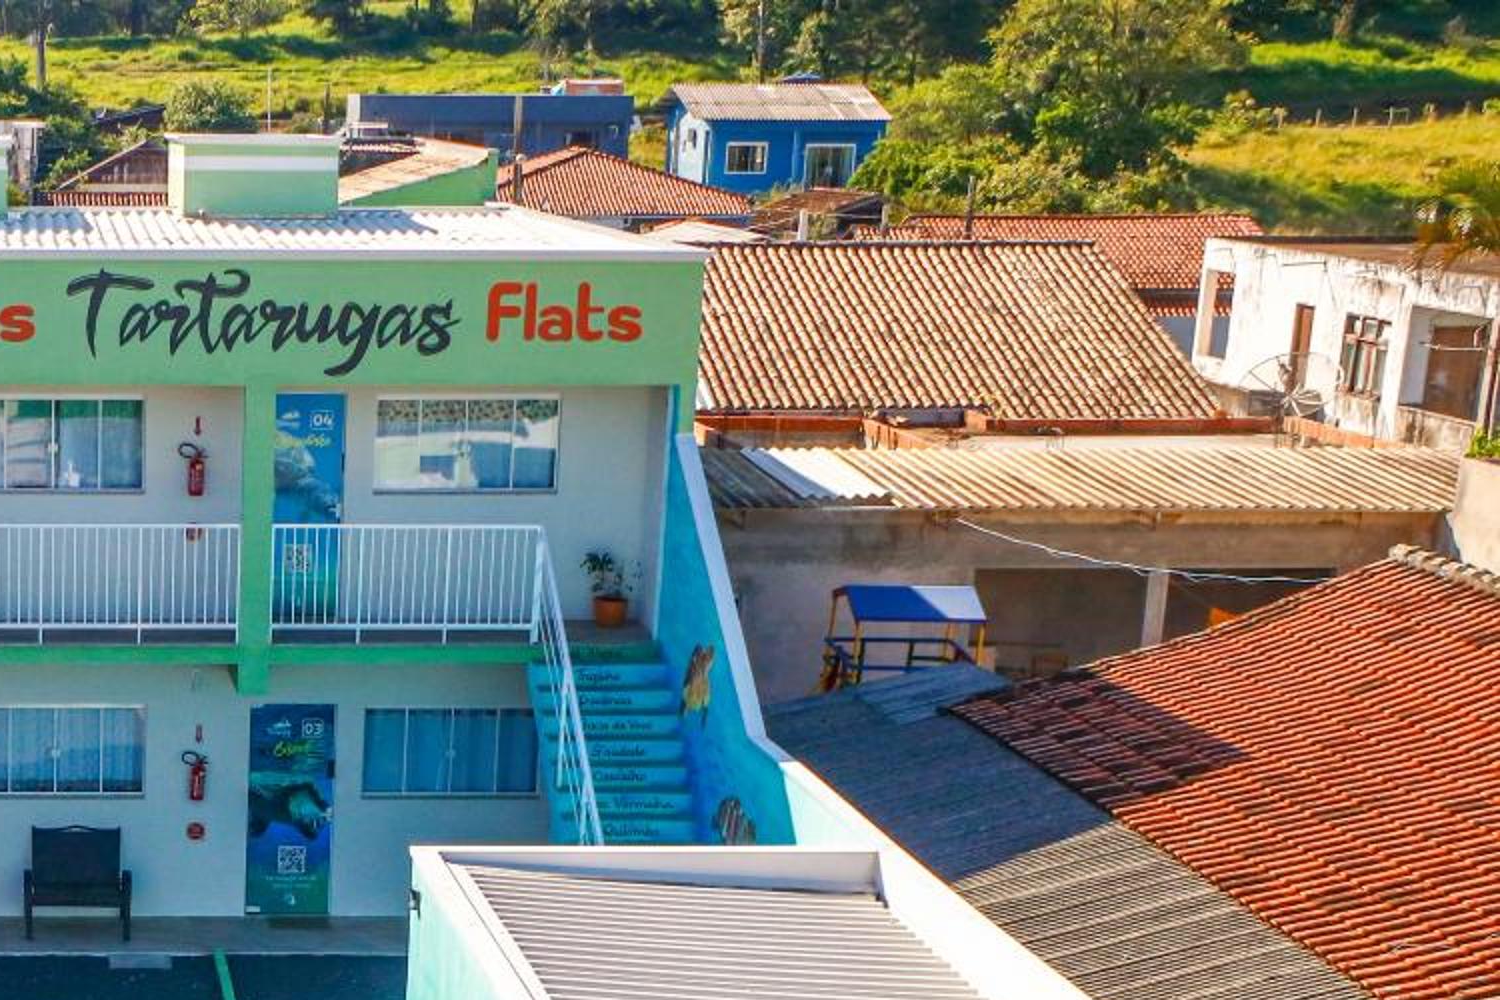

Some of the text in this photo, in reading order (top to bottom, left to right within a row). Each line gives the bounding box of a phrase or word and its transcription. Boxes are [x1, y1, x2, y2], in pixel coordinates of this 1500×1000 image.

[66, 267, 461, 376] Tartarugas
[485, 282, 642, 342] Flats
[305, 723, 323, 735] 03
